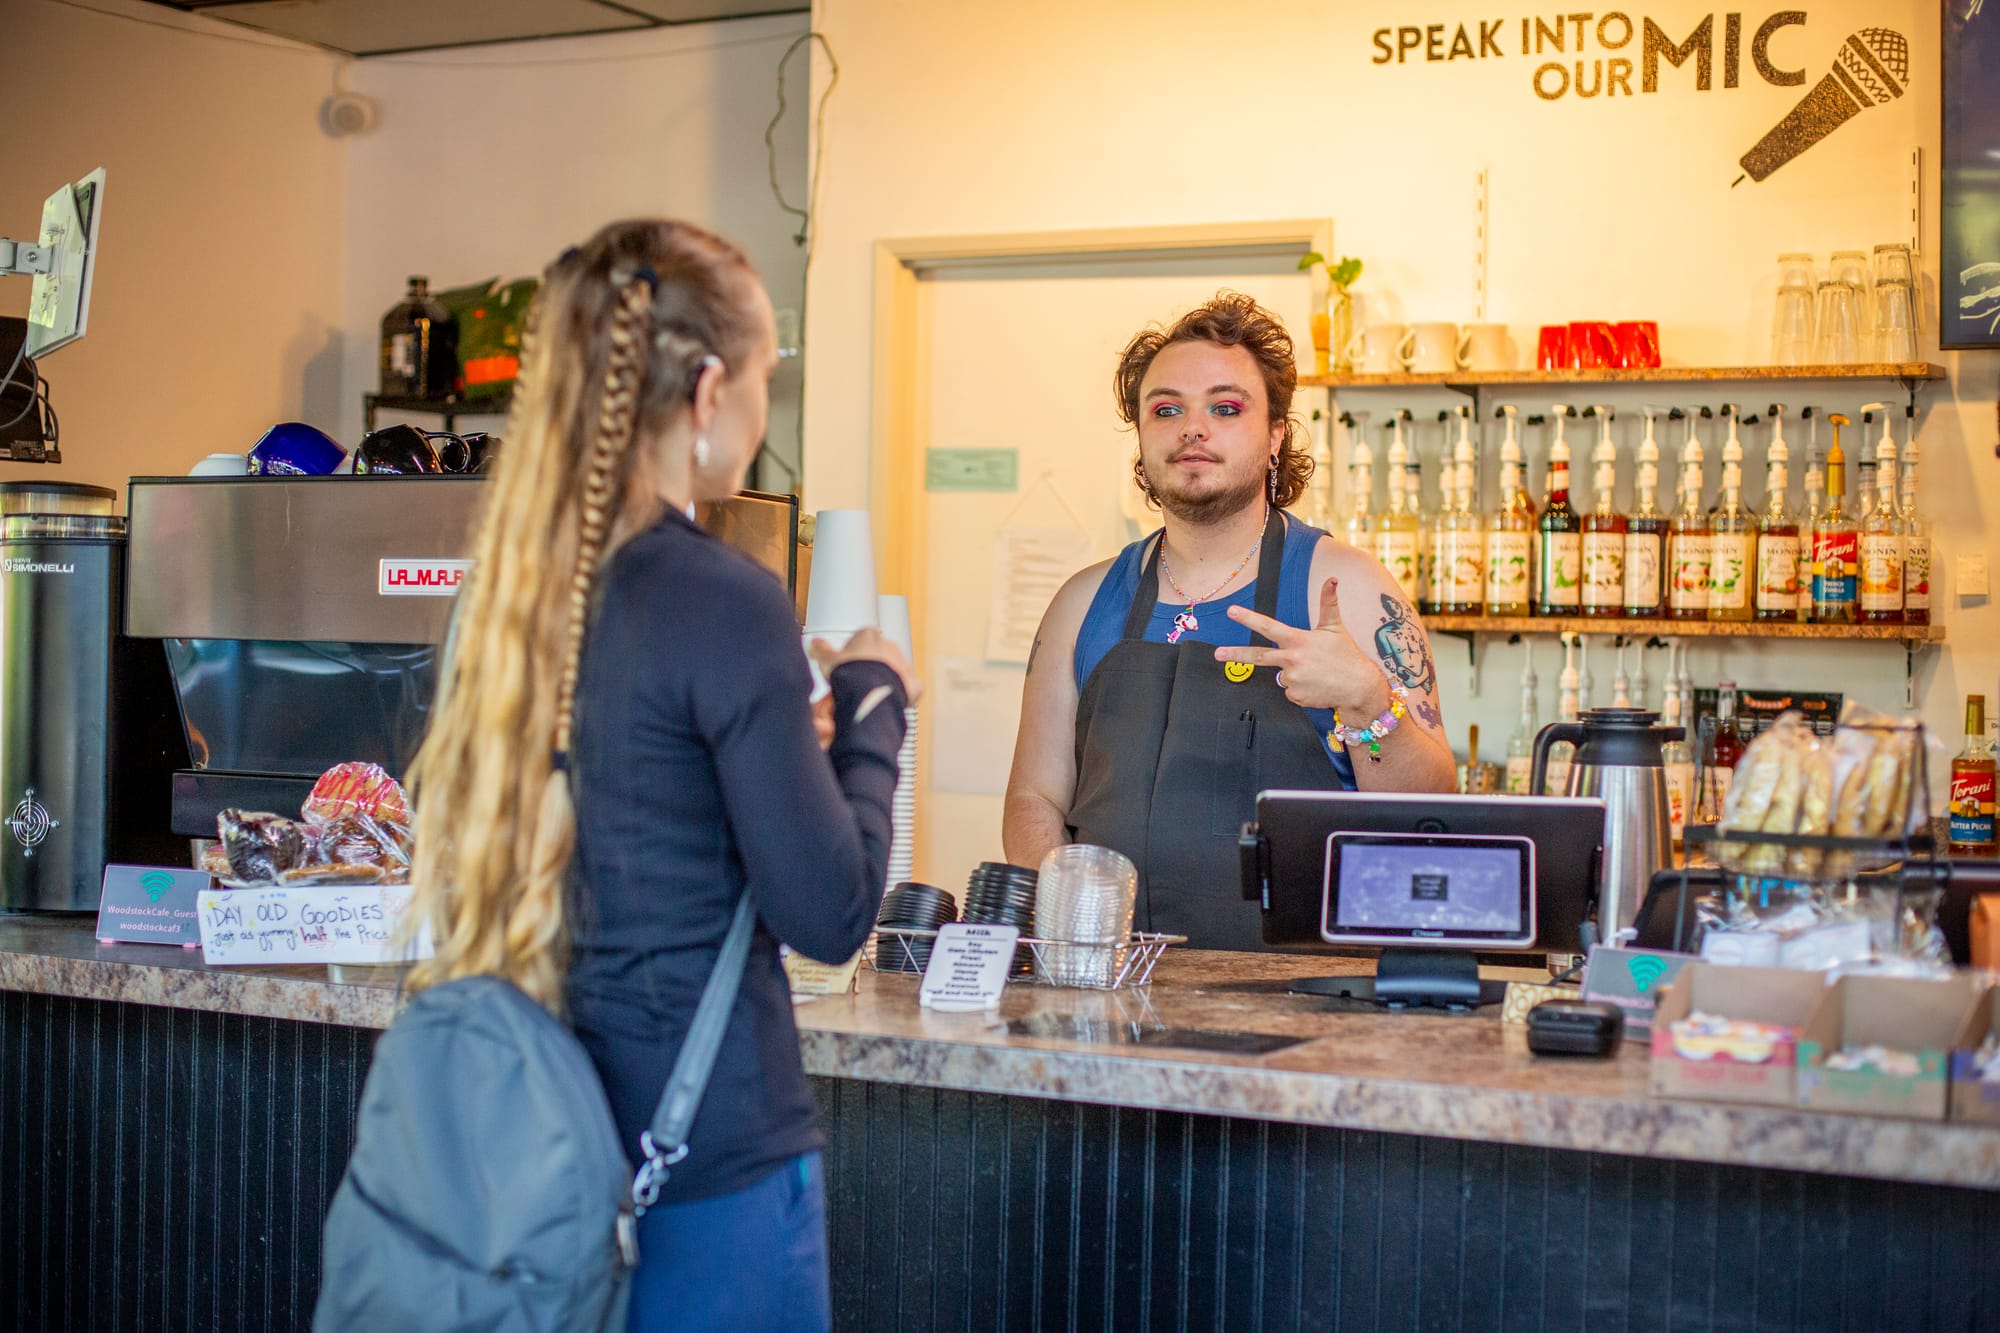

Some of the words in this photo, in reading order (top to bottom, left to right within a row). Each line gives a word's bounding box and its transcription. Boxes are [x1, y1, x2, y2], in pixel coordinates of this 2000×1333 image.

[1372, 19, 1504, 65] SPEAK
[1521, 11, 1634, 55] INTO
[1533, 57, 1634, 101] OUR
[1642, 10, 1808, 93] MIC
[1815, 539, 1856, 562] Torani
[12, 563, 75, 573] SIMONELLI
[388, 569, 409, 586] LA
[1951, 778, 1992, 801] Torani
[1971, 822, 1992, 831] PECAN
[257, 903, 288, 922] OLD
[301, 903, 384, 924] GOODIES
[213, 931, 235, 947] just
[240, 932, 254, 940] as
[300, 926, 328, 942] half
[335, 928, 352, 939] the
[966, 928, 991, 936] Milk
